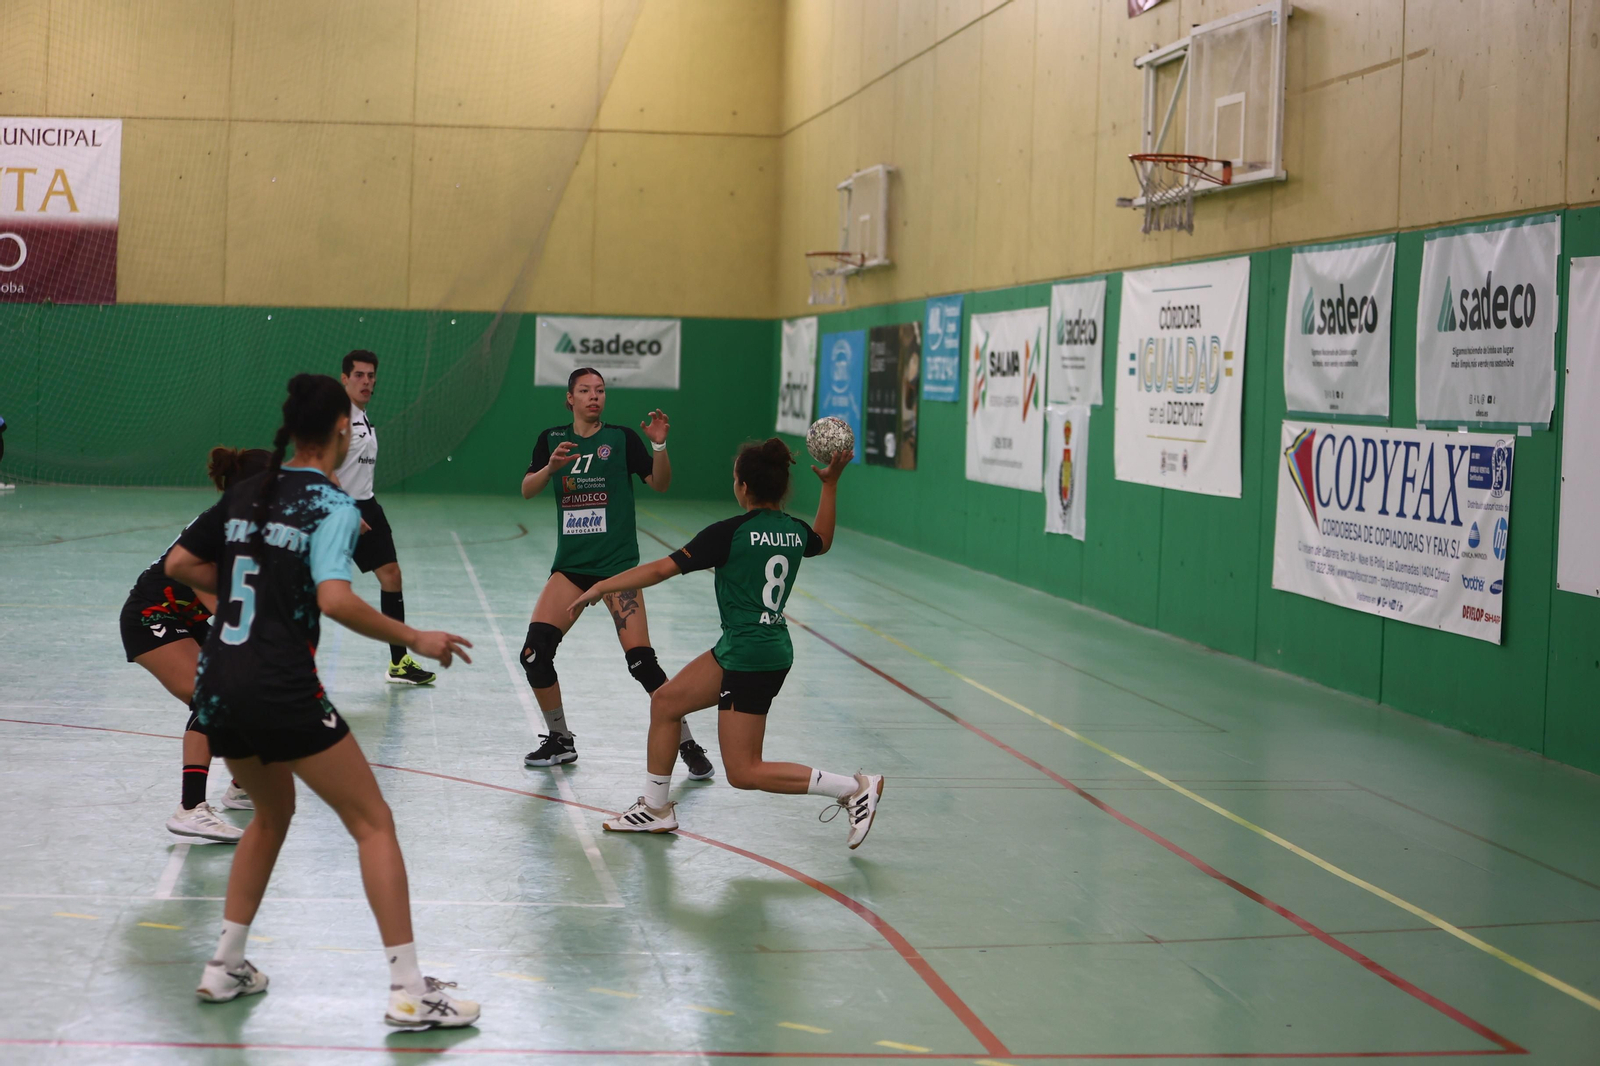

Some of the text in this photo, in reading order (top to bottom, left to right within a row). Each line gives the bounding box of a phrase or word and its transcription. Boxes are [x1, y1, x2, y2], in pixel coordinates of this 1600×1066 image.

[0, 128, 102, 147] UNICIPAL
[0, 167, 80, 213] TA
[1159, 301, 1202, 330] CÓRDOBA
[1317, 284, 1379, 336] sadeco
[1458, 270, 1537, 332] sadeco
[578, 333, 662, 356] sadeco
[1138, 335, 1221, 394] IGUALDAD
[1167, 401, 1204, 427] DEPORTE
[570, 454, 594, 474] 27
[1315, 434, 1469, 527] COPYFAX
[572, 493, 607, 503] IMDECO
[750, 531, 803, 547] PAULITA
[1322, 518, 1362, 543] CORDOBESA
[1363, 524, 1373, 544] DE
[1375, 526, 1424, 554] COPIADORAS
[1426, 536, 1432, 555] Y
[1433, 536, 1450, 558] FAX
[762, 554, 789, 612] 8
[1462, 574, 1485, 592] brother
[219, 555, 260, 646] 5
[1462, 605, 1484, 622] DEVELOP
